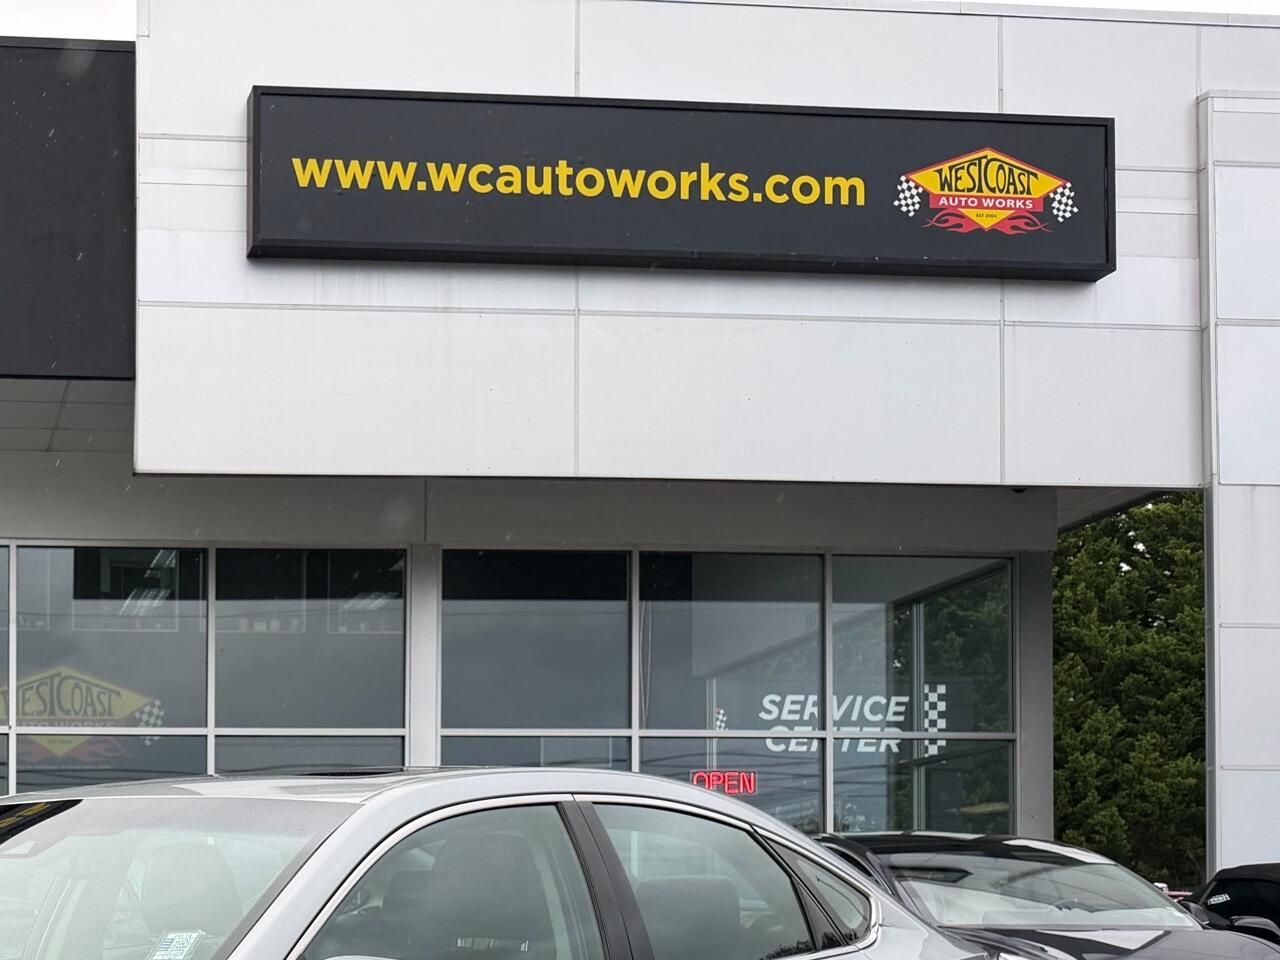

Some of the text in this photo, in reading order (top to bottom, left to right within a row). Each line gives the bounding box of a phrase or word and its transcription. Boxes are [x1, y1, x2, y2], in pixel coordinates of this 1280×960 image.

[292, 158, 865, 206] www.wcautoworks.com
[938, 196, 1033, 209] AUTO WORKS
[758, 693, 910, 722] SERVICE
[693, 771, 755, 794] OPEN
